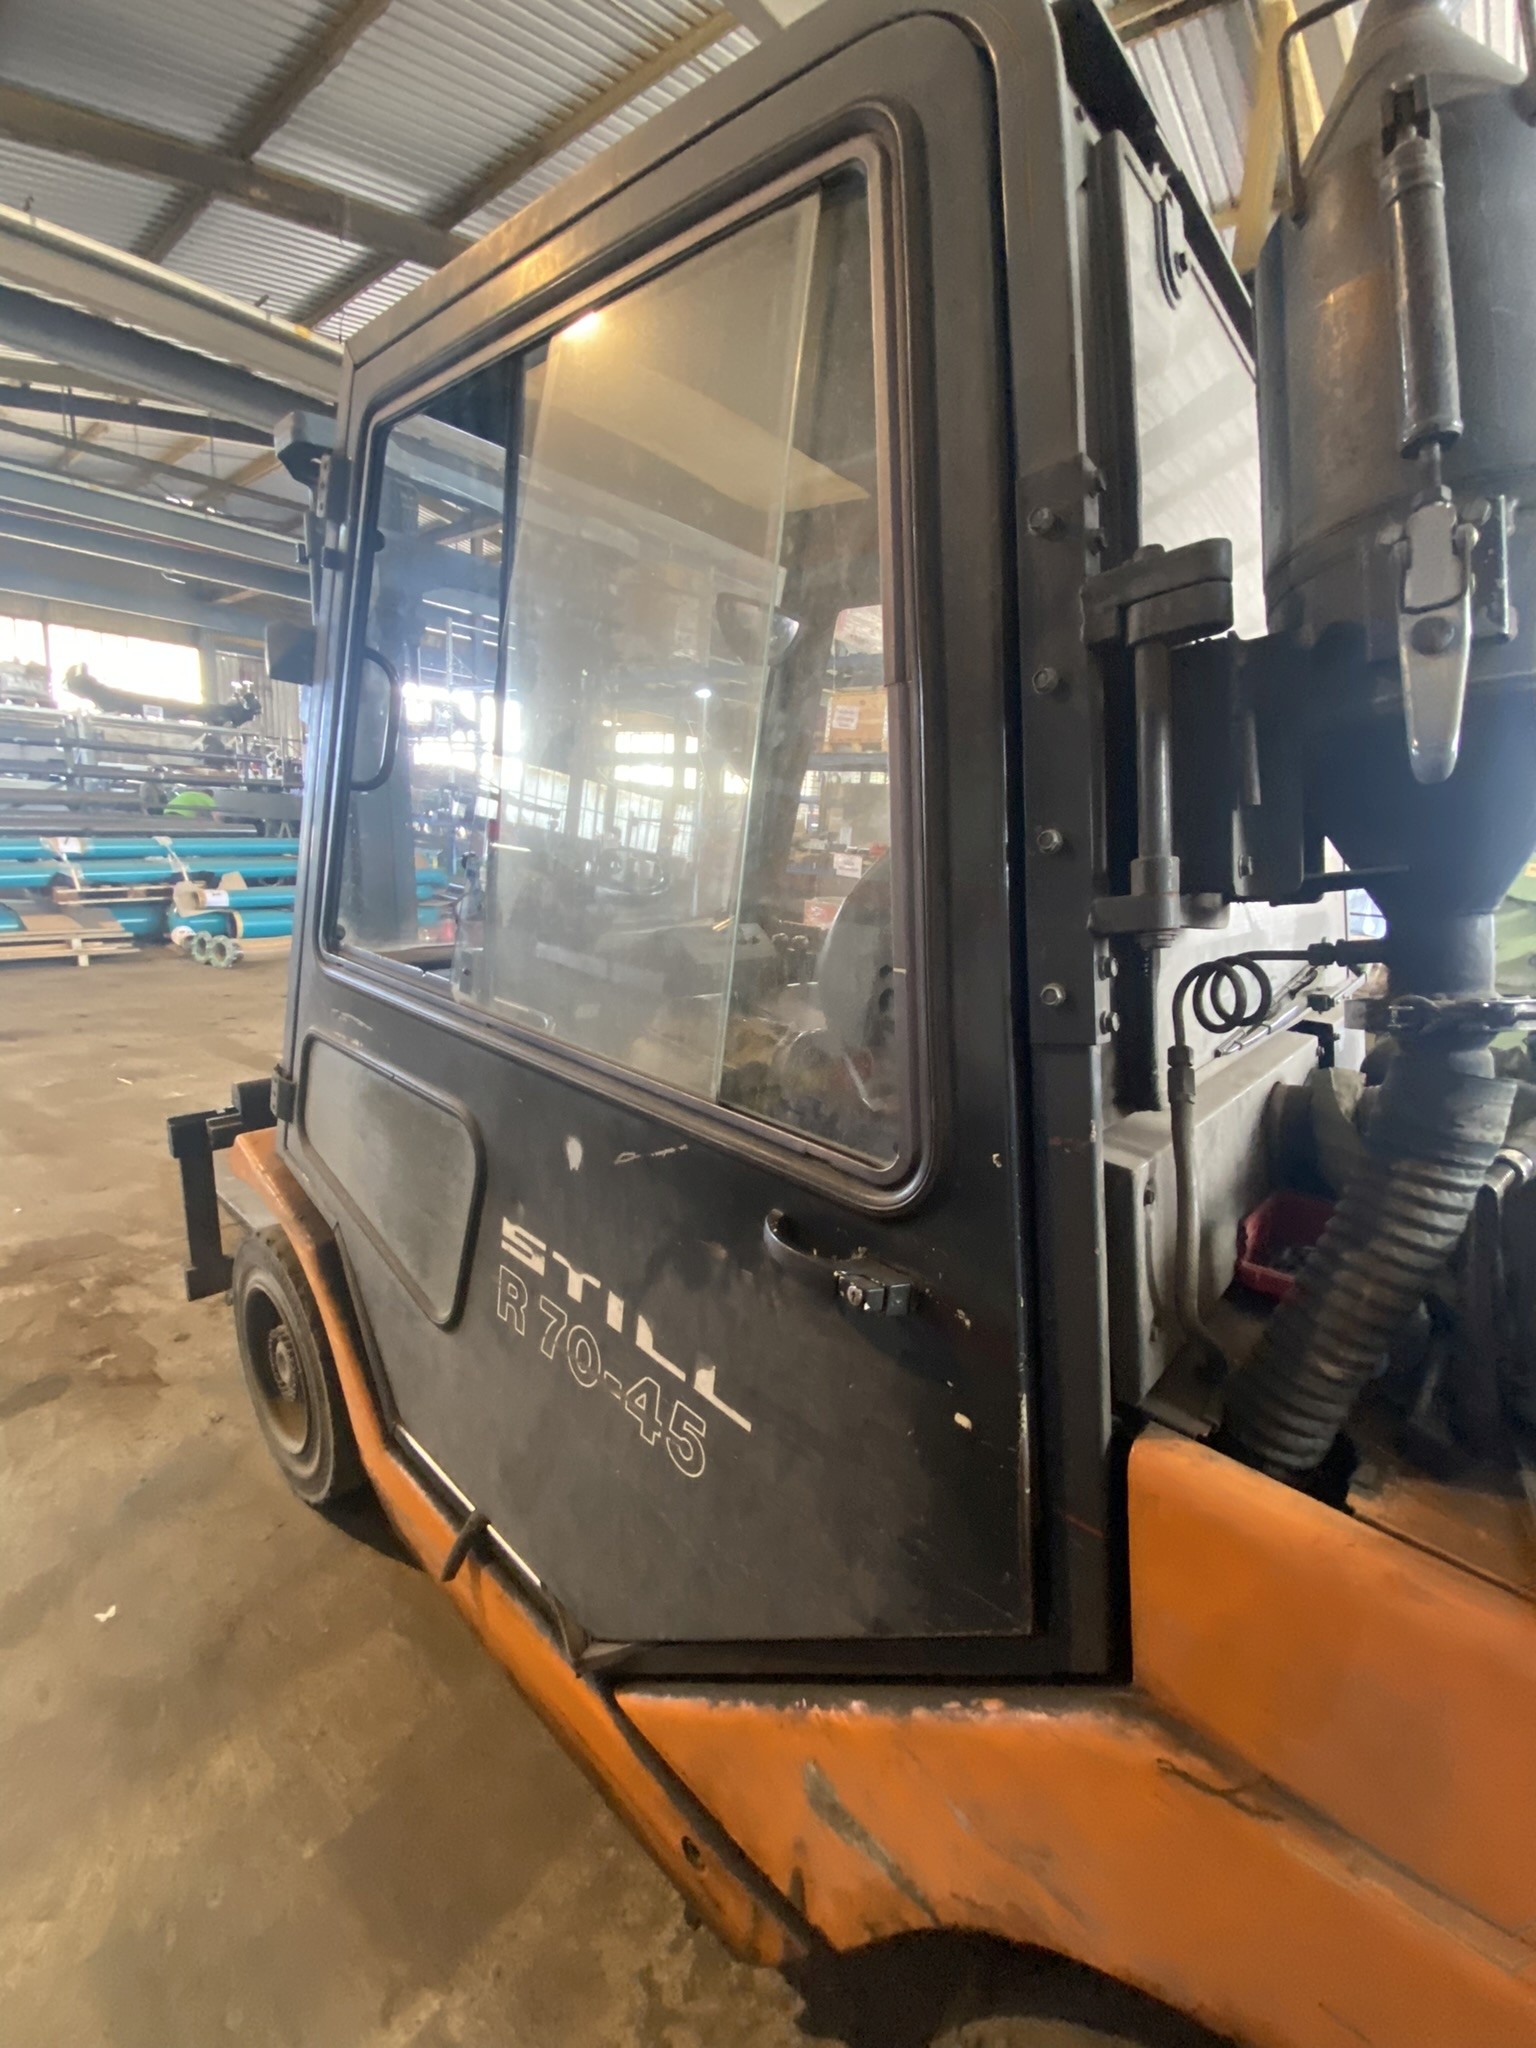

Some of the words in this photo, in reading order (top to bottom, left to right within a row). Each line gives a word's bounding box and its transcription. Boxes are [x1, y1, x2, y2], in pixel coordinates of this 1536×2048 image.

[497, 1264, 528, 1336] R
[539, 1296, 707, 1478] 70-45
[501, 1216, 752, 1433] STILL
